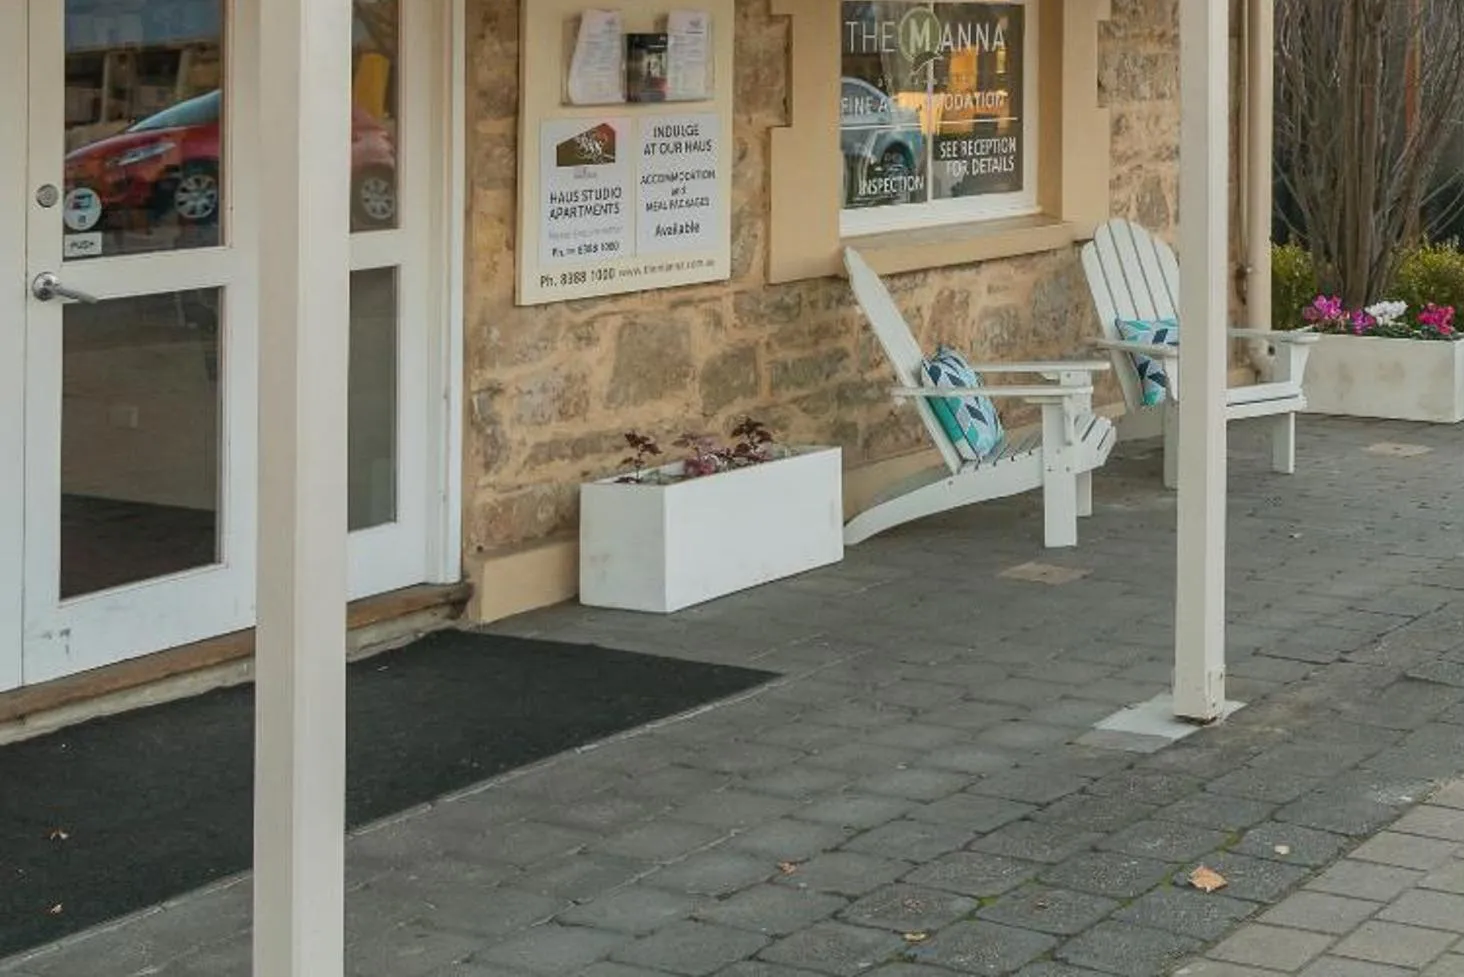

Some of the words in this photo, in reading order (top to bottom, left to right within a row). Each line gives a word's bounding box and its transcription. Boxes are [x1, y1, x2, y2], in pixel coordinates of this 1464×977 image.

[845, 20, 896, 53] THE
[908, 17, 1006, 54] MANNA
[878, 91, 1004, 114] AODATION
[653, 124, 700, 139] INDULGE
[643, 143, 657, 156] AT
[659, 142, 682, 155] OUR
[684, 138, 712, 153] HAUS
[939, 142, 958, 159] SEE
[960, 137, 1016, 156] RECEPTION
[946, 159, 969, 177] FOR
[971, 156, 1015, 176] DETAILS
[550, 190, 579, 204] HAUS
[581, 186, 622, 202] STUDIO
[858, 175, 924, 196] INSPECTION
[549, 203, 620, 220] APARTMENTS
[655, 220, 700, 237] Available
